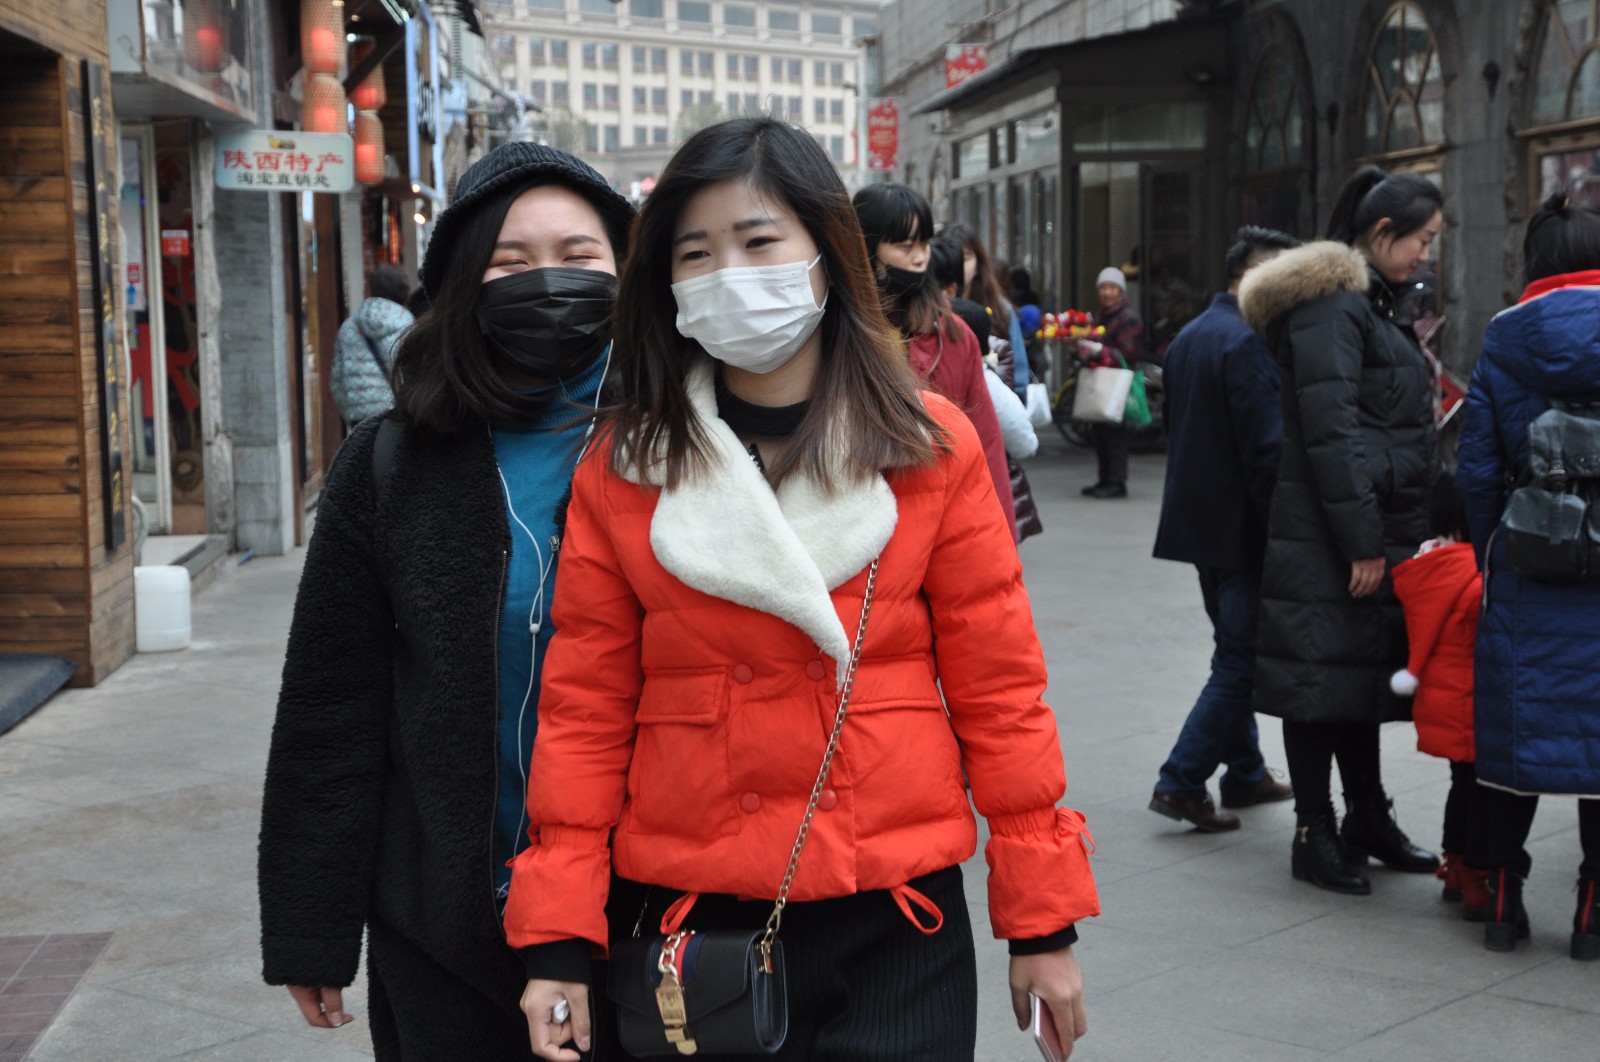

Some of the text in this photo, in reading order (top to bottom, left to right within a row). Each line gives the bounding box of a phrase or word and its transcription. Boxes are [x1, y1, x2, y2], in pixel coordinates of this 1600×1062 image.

[222, 150, 344, 172] 陕西特产
[237, 172, 330, 187] 淘宝直销处
